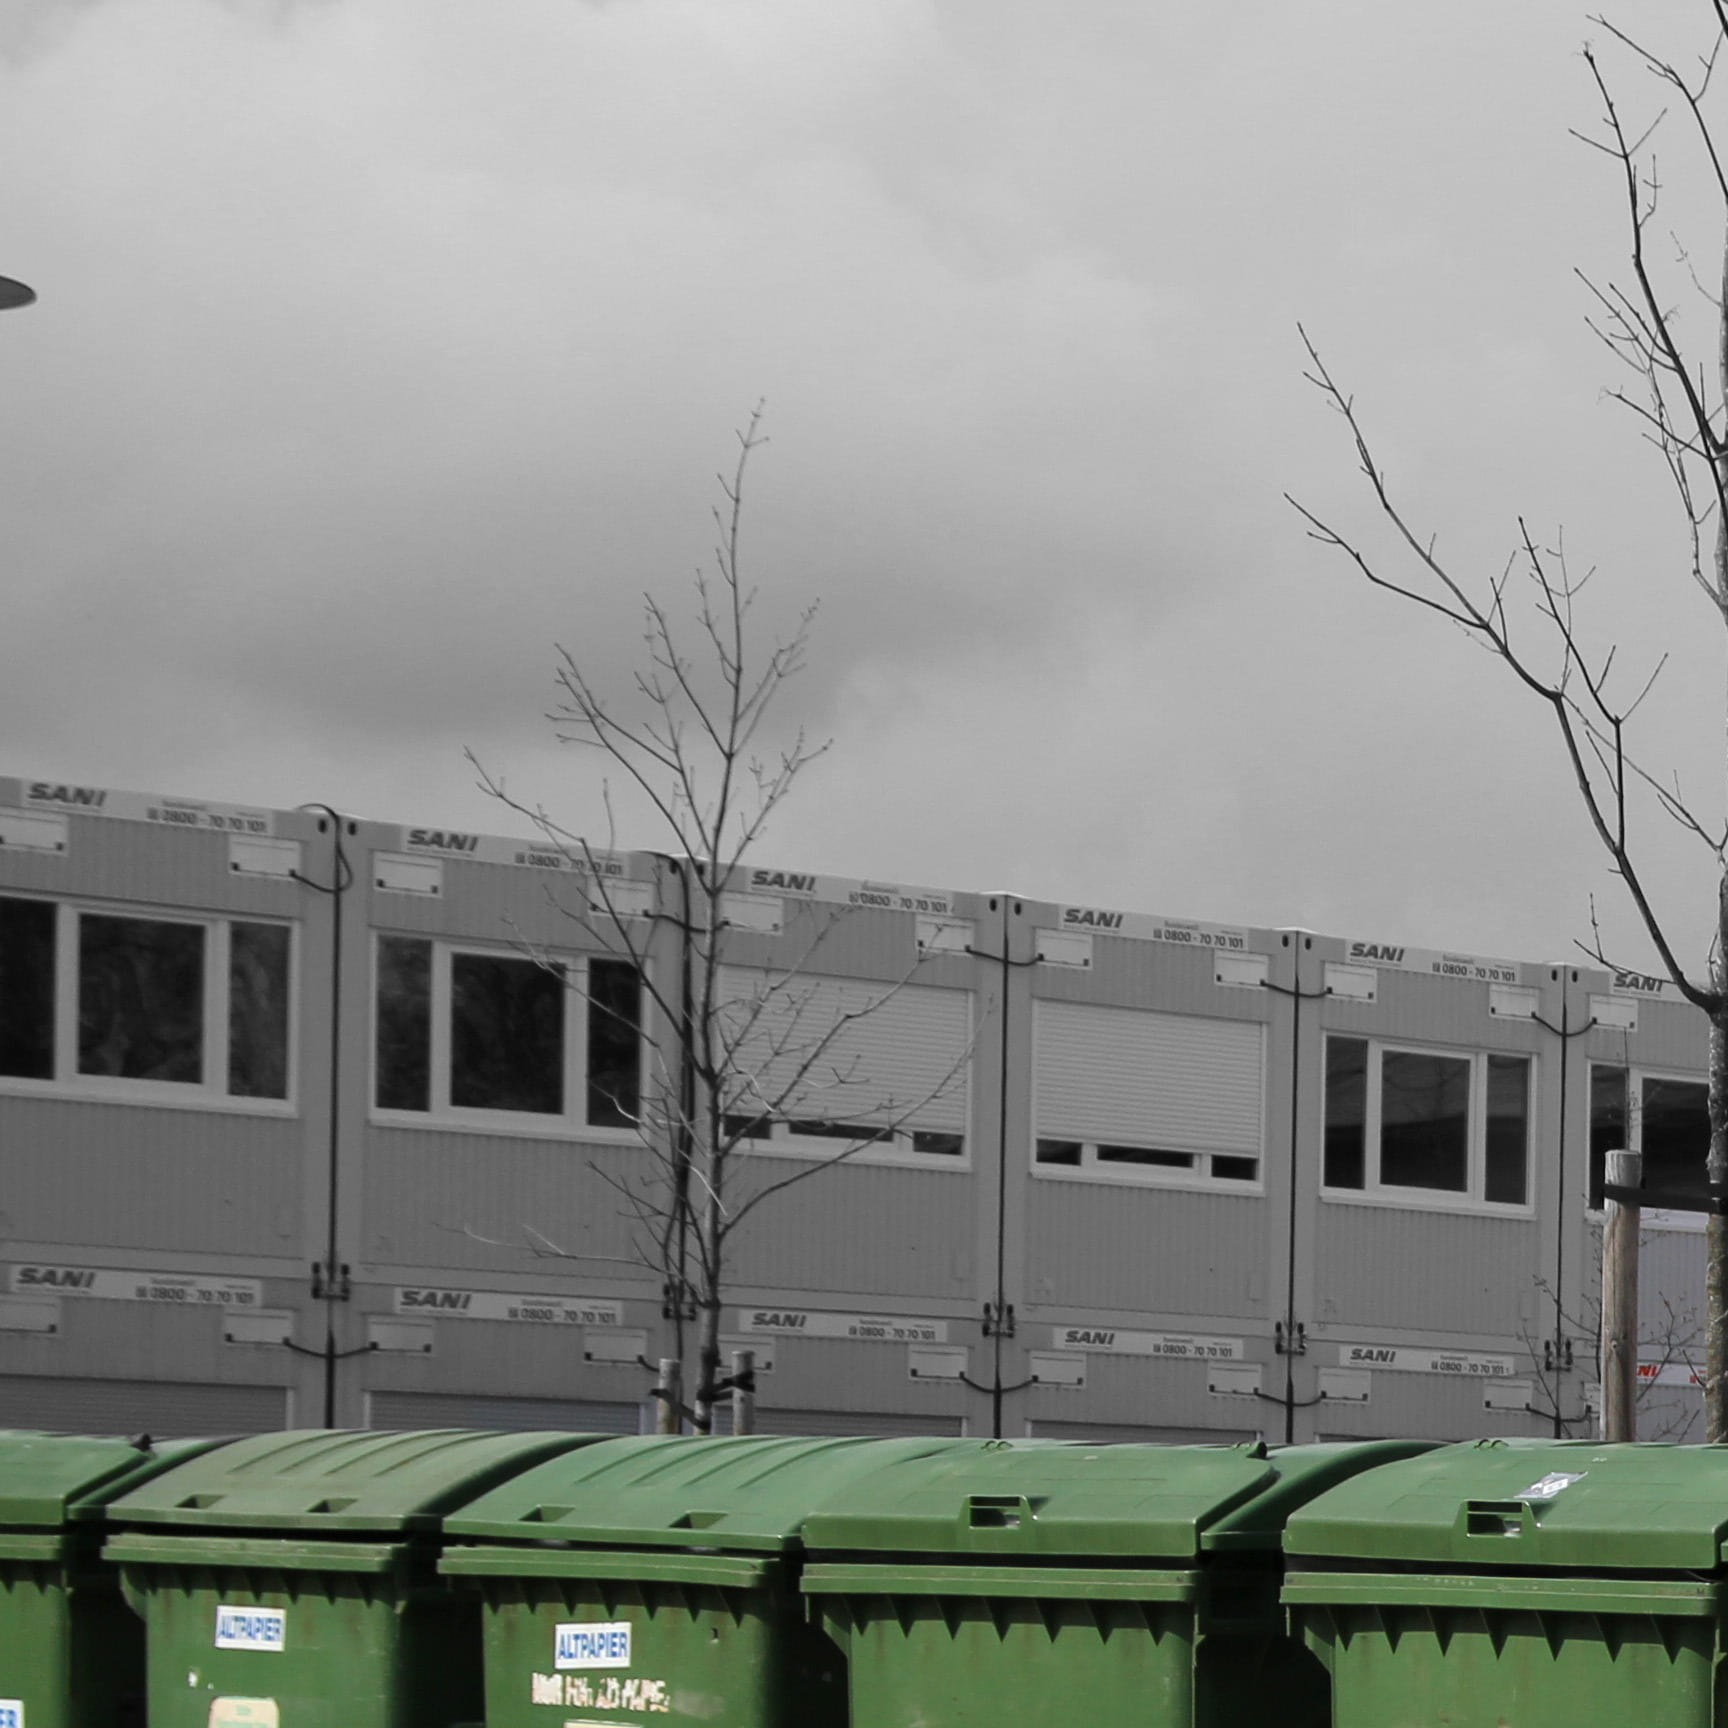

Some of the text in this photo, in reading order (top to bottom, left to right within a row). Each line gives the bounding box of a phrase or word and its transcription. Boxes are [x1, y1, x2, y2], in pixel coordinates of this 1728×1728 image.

[28, 783, 107, 807] SANI
[408, 830, 479, 851] SANI
[752, 870, 816, 891] SANI
[860, 893, 947, 913] 0800 70 70 101
[1064, 908, 1123, 928] SANI
[1164, 930, 1243, 949] 0800 70 70 101
[1350, 943, 1405, 962] SANI
[1442, 964, 1468, 976] 0800
[1475, 967, 1486, 978] 70
[1488, 969, 1499, 980] 70
[1502, 971, 1516, 982] 101
[1614, 974, 1663, 992] SANI
[16, 1268, 96, 1288] SANI
[400, 1290, 471, 1310] SANI
[521, 1308, 616, 1323] 0800 70 70 101
[752, 1312, 807, 1328] SANI
[859, 1326, 935, 1340] 0800 70 70 101
[1065, 1330, 1115, 1345] SANI
[1162, 1344, 1232, 1357] 0800 70 70 101
[1350, 1348, 1396, 1363] SANI
[1439, 1361, 1504, 1374] 0800 70 70 101
[558, 1632, 628, 1659] ALTPAPIER
